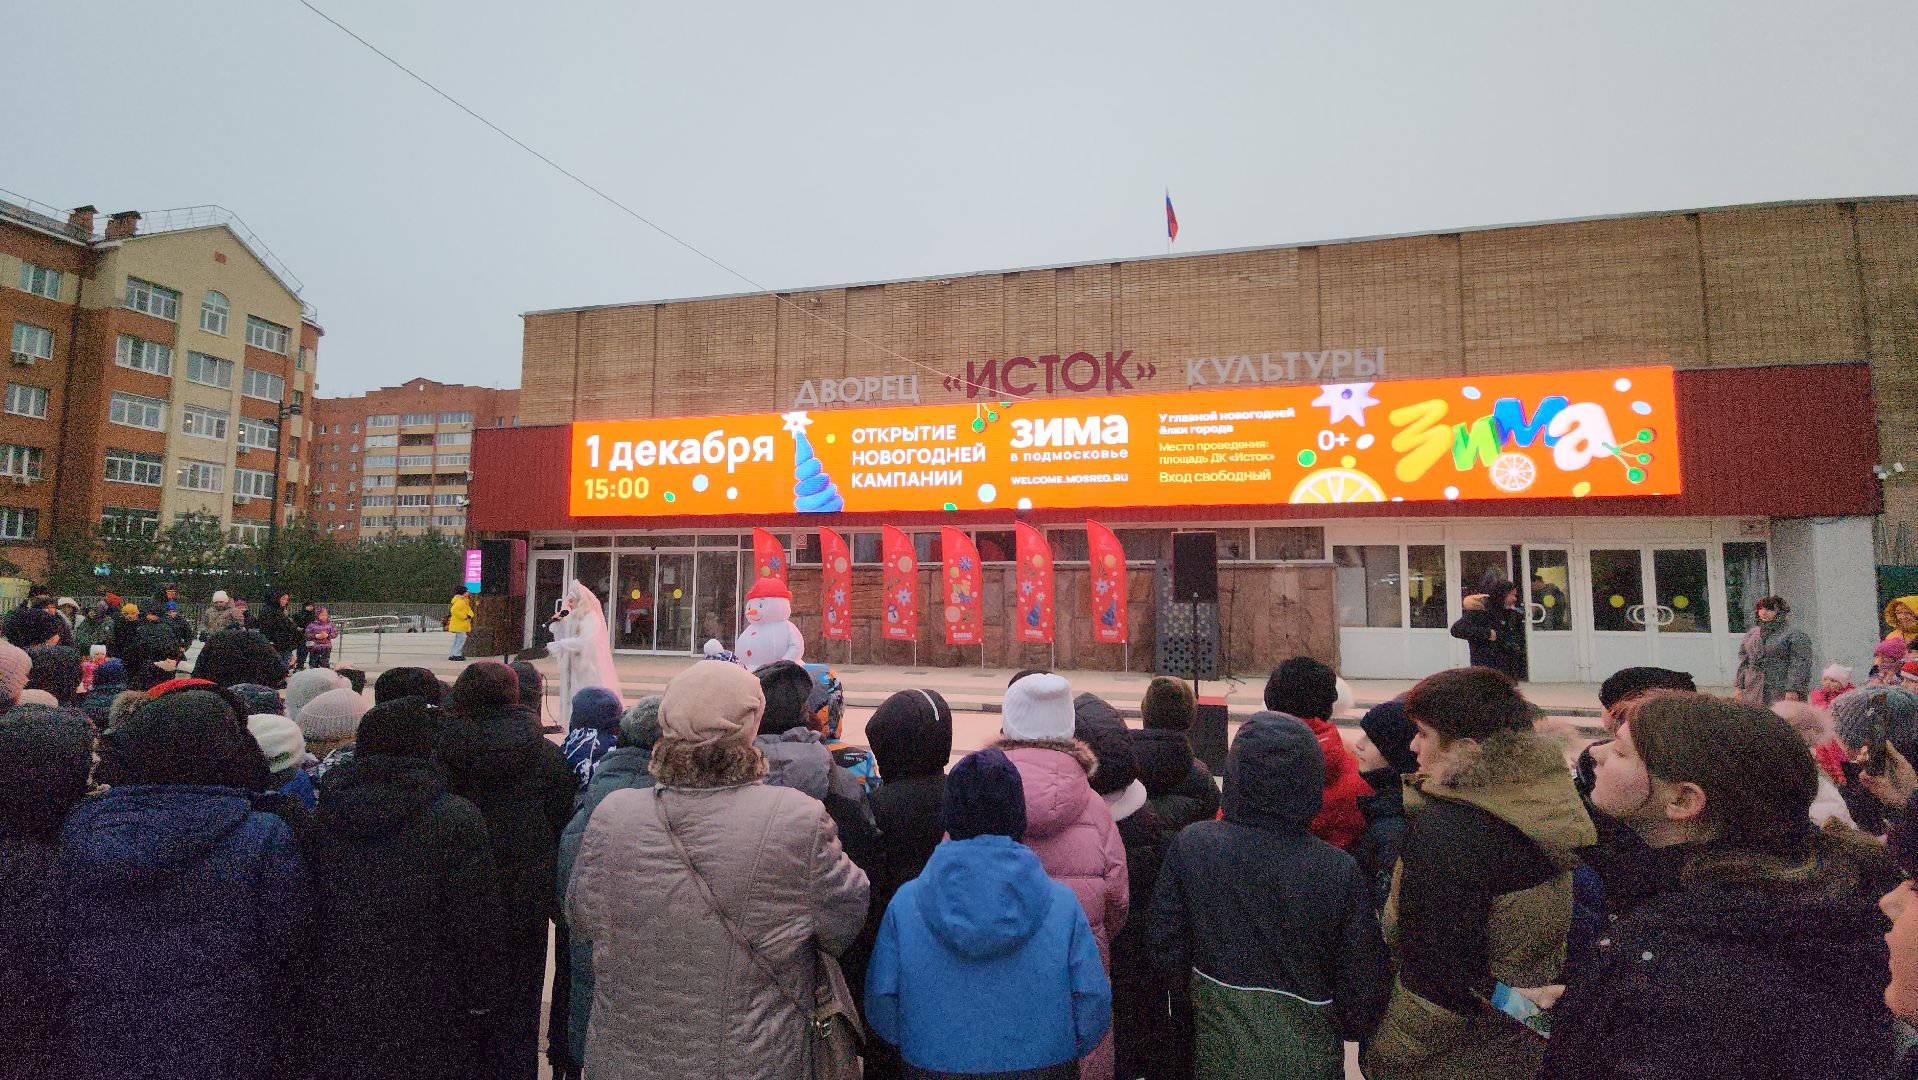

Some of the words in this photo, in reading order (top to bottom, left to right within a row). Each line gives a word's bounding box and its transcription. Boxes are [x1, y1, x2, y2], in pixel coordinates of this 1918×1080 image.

[794, 374, 919, 407] ДВОРЕЦ
[943, 350, 1156, 400] «ИСТОК»
[1186, 347, 1386, 386] КУЛЬТУРЫ
[1168, 410, 1218, 423] главной
[1219, 407, 1296, 420] новогодней
[851, 424, 957, 444] ОТКРЫТИЕ
[1190, 424, 1234, 435] города
[1159, 442, 1195, 452] Место
[1196, 440, 1270, 452] проведения:
[1317, 430, 1351, 451] 0+
[586, 434, 600, 468] 1
[609, 429, 774, 473] декабря
[851, 443, 986, 466] НОВОГОДНЕЙ
[1023, 447, 1129, 463] подмосковье
[1159, 456, 1209, 465] площадь
[1210, 453, 1228, 463] ДК
[1228, 452, 1276, 463] «Исток»
[851, 470, 963, 489] КАМПАНИИ
[1010, 473, 1129, 486] WELCOME.MOSREG.RU
[1159, 471, 1193, 484] Вход
[1194, 468, 1272, 482] свободный
[584, 476, 649, 500] 15:00
